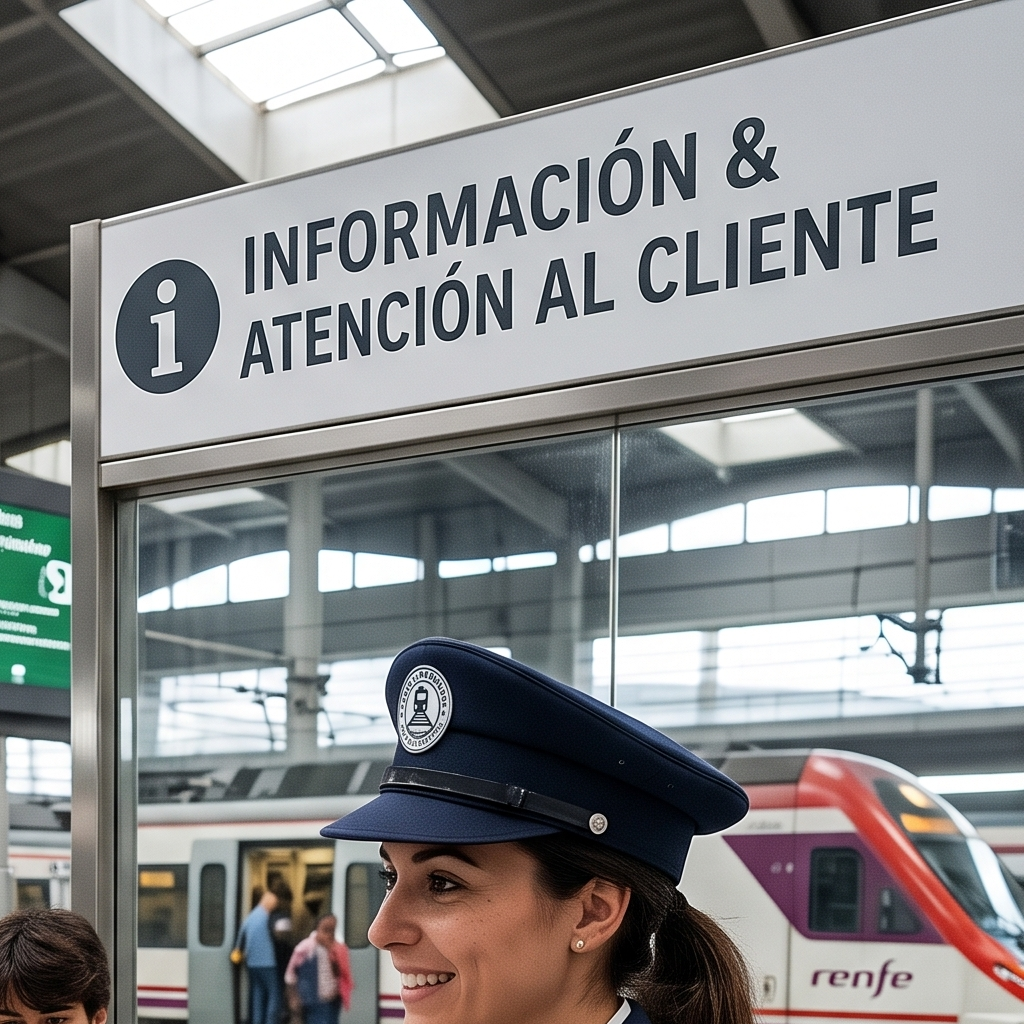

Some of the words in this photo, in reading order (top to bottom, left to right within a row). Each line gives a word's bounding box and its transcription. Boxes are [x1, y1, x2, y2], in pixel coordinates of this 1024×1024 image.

[239, 261, 514, 379] ATENCIÓN
[535, 251, 615, 325] AL
[638, 180, 938, 304] CLIENTE
[246, 127, 697, 295] INFORMACIÓN
[725, 117, 780, 189] &
[810, 958, 914, 999] renfe
